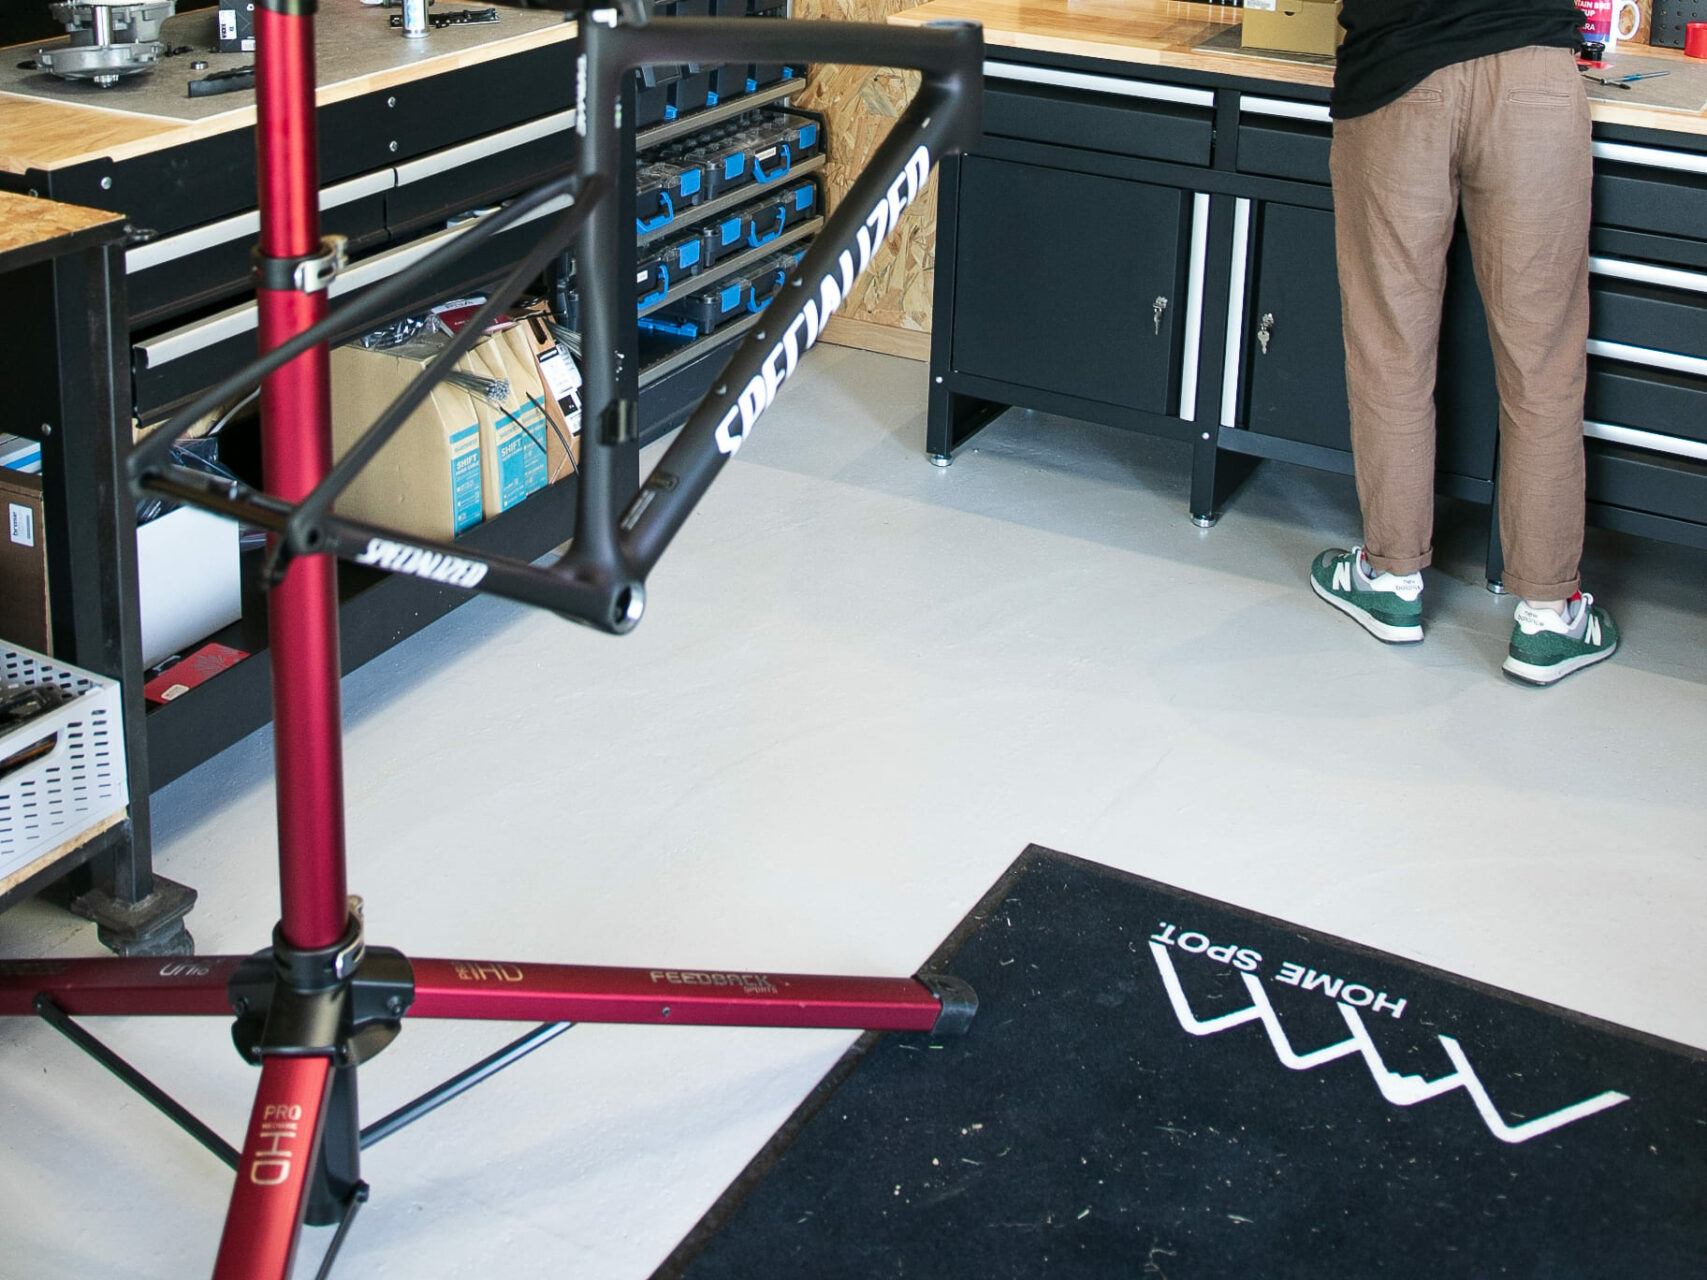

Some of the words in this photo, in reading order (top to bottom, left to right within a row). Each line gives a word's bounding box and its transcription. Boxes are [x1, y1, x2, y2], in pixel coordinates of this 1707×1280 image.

[1574, 0, 1593, 8] NTAIN
[1583, 8, 1596, 17] UP
[714, 145, 930, 457] SPECIALIZED
[1150, 921, 1263, 971] SPOT.
[649, 970, 772, 988] FEEDBACK
[1275, 961, 1408, 1019] HOME
[263, 1104, 302, 1121] PRO
[250, 1131, 297, 1185] HD
